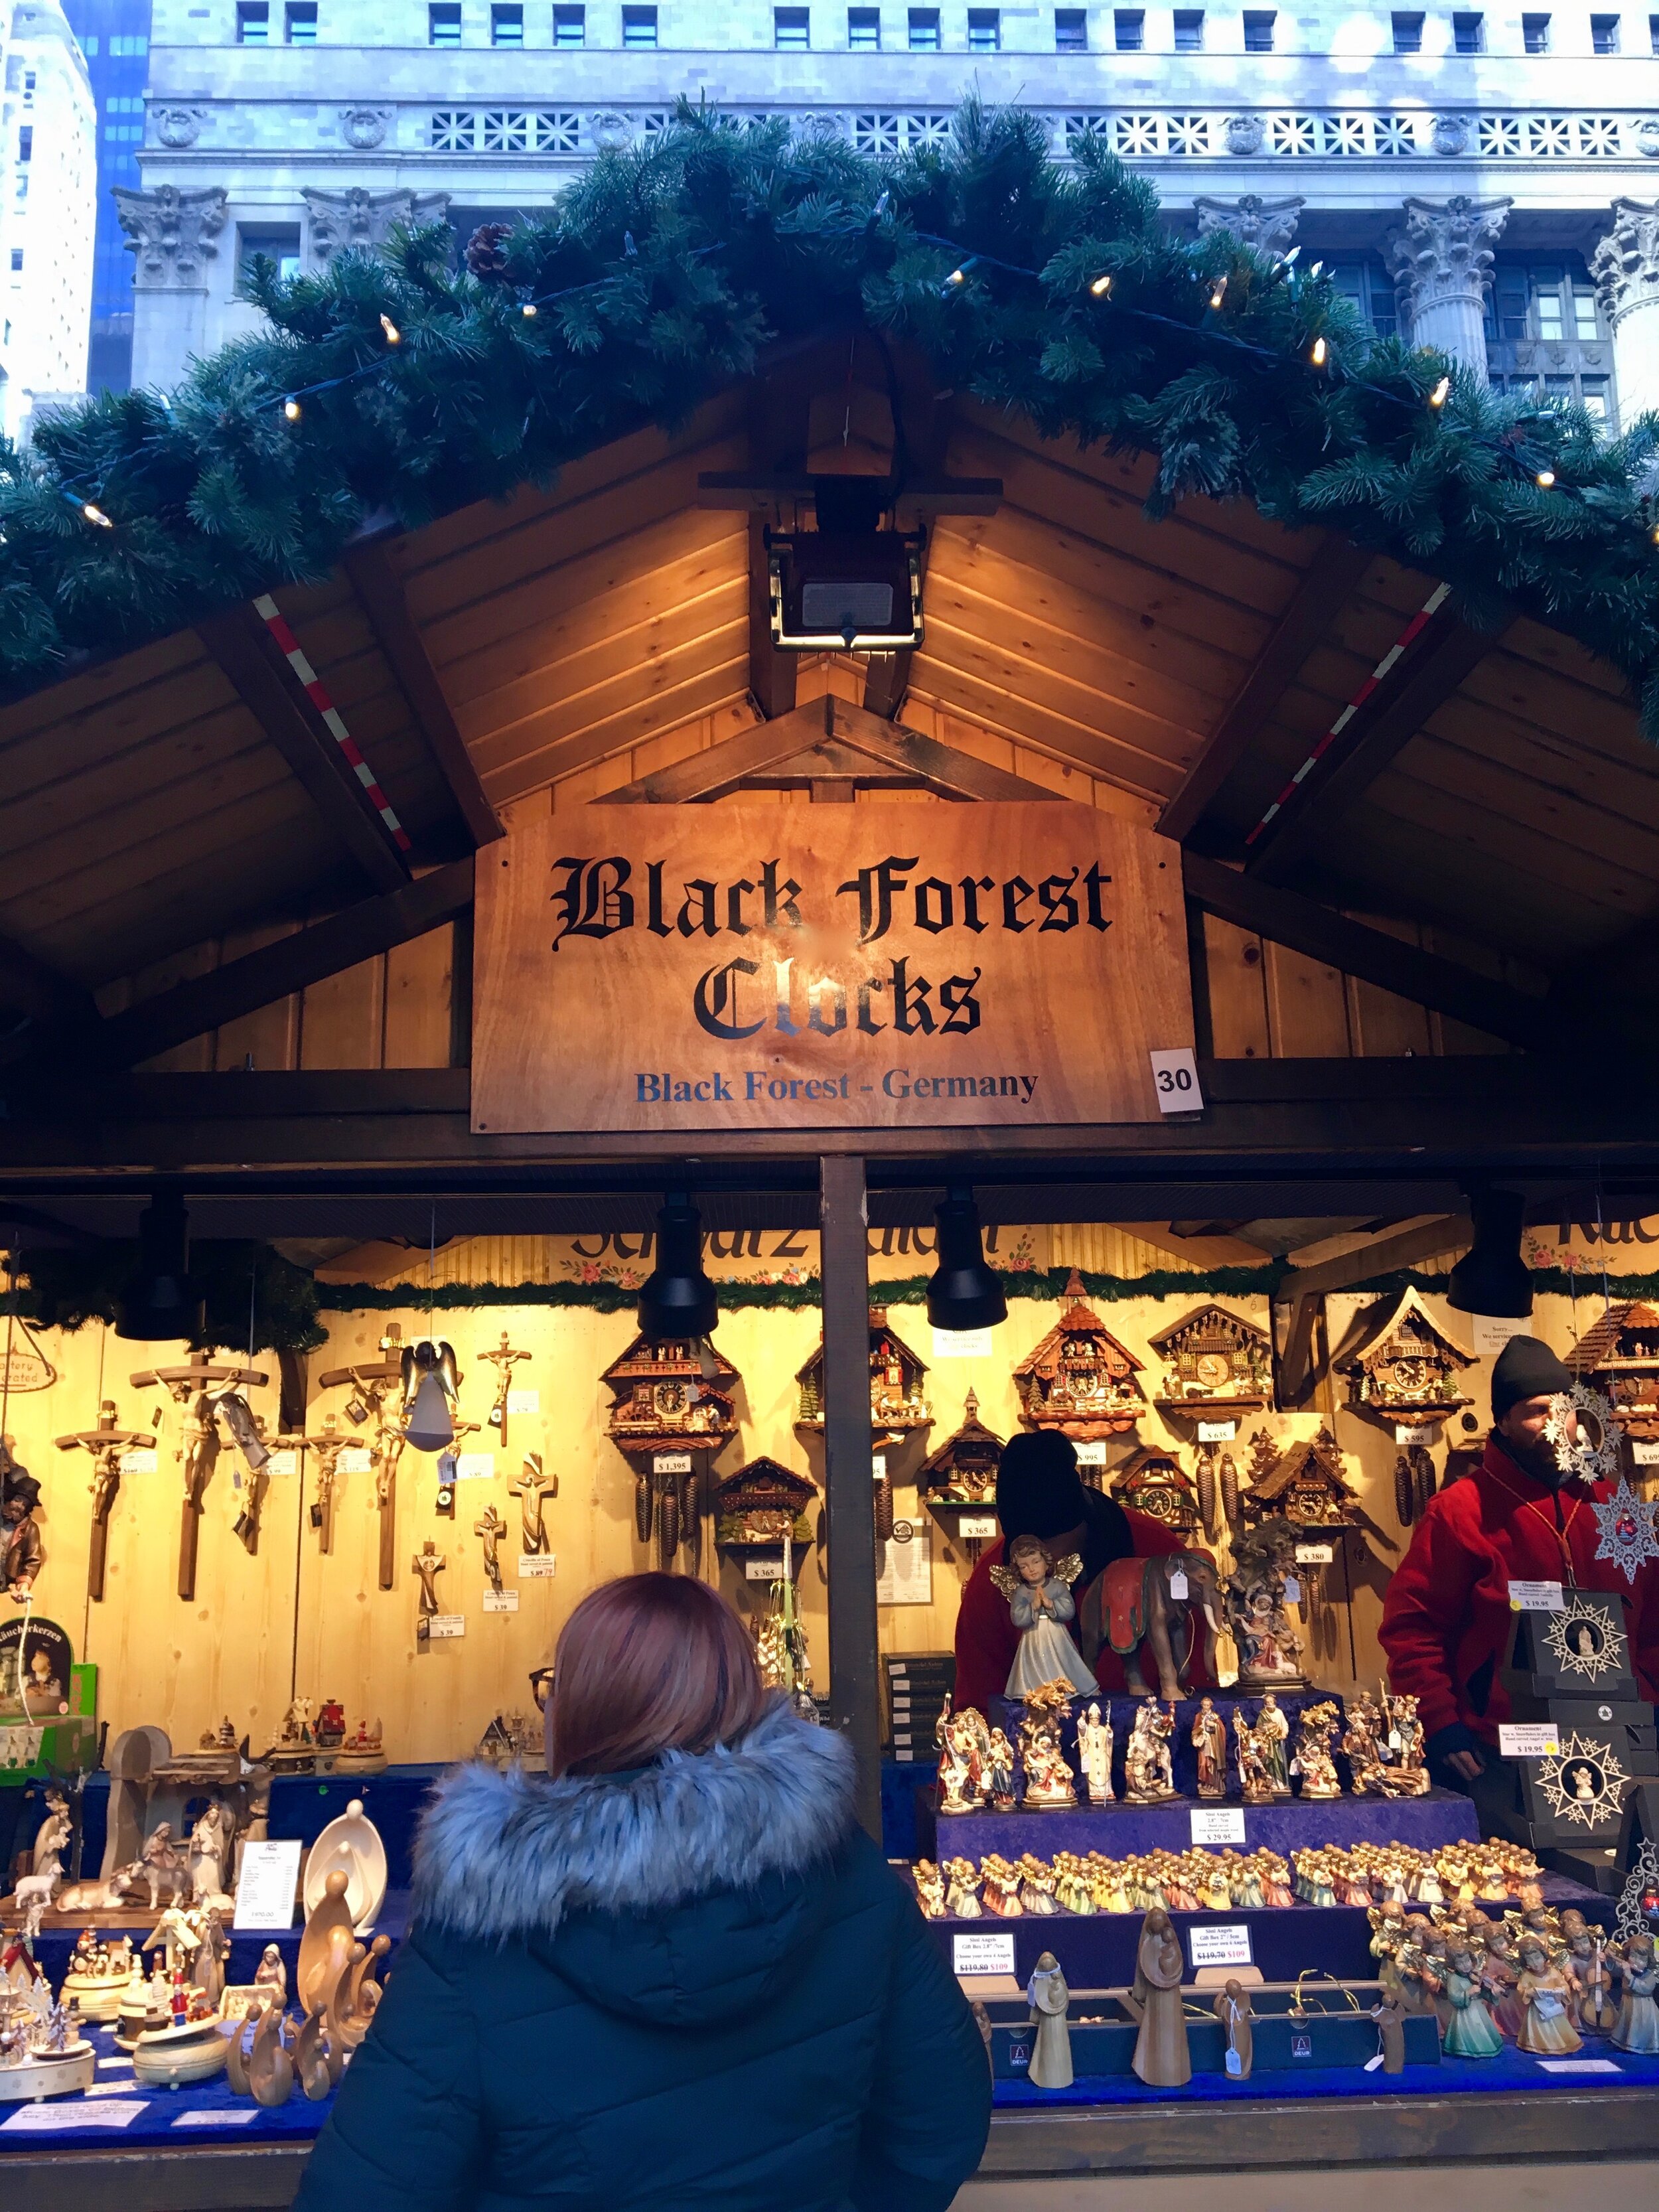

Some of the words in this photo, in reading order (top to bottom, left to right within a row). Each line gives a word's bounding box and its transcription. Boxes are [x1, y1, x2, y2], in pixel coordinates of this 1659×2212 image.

[549, 856, 803, 952] Black
[835, 855, 1114, 950] Forest
[693, 956, 982, 1040] Clocks
[634, 1072, 734, 1102] Black
[743, 1070, 851, 1100] Forest
[882, 1069, 1039, 1104] Germany
[1157, 1069, 1192, 1092] 30
